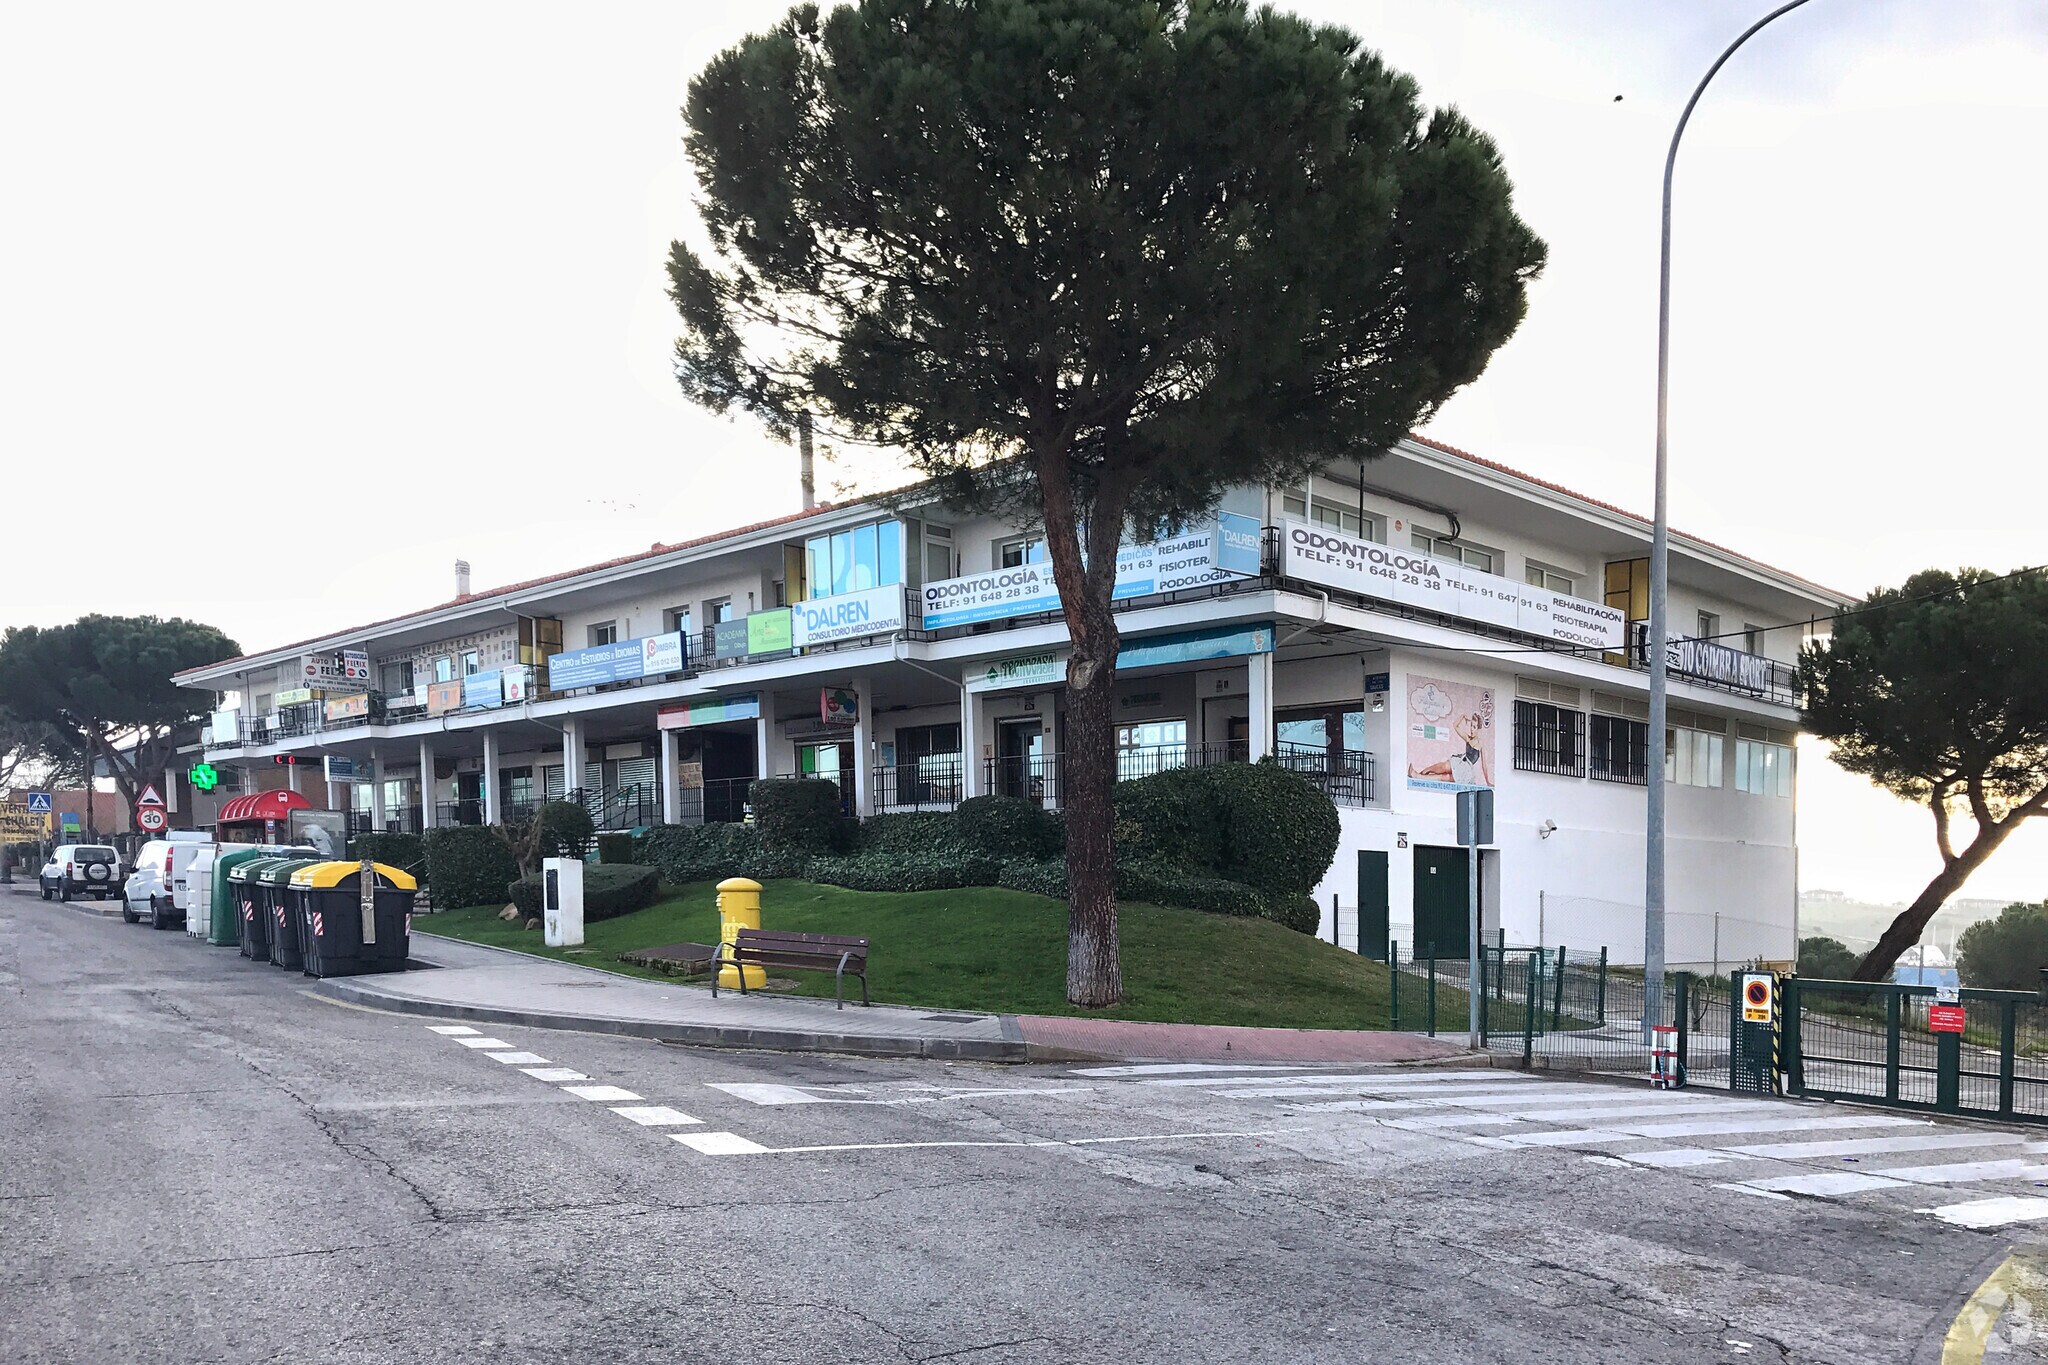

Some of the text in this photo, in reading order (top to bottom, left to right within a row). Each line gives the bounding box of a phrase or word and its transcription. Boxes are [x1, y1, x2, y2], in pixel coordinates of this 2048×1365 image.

[1225, 530, 1259, 548] DALREN
[1292, 528, 1440, 578] ODONTOLOGÍA
[1120, 559, 1153, 573] 91 63
[1294, 546, 1441, 590] TELF: 91 648 28 38
[926, 568, 1038, 600] ODONTOLOGÍA
[1445, 578, 1548, 612] TELF: 91 647 91 63
[928, 599, 960, 611] TELF:
[963, 596, 976, 605] 91
[980, 592, 1002, 603] 648
[1006, 588, 1020, 598] 28
[1025, 585, 1039, 595] 38
[1553, 597, 1621, 623] REHABILITACIÓN
[806, 600, 869, 631] DALREN
[1553, 613, 1607, 634] FISIOTERAPIA
[717, 629, 747, 640] ACADEMIA
[808, 618, 900, 641] CONSULTORIO MEDICODENTAL
[1553, 628, 1605, 648] PODOLOGÍA
[551, 658, 574, 670] CENTRO
[581, 651, 611, 663] ESTUDIOS
[615, 645, 640, 658] IDIOMAS
[1001, 654, 1055, 679] TECNOCASA
[1695, 642, 1738, 683] COIMBRA
[1740, 654, 1766, 690] SPORT
[144, 815, 160, 823] 30
